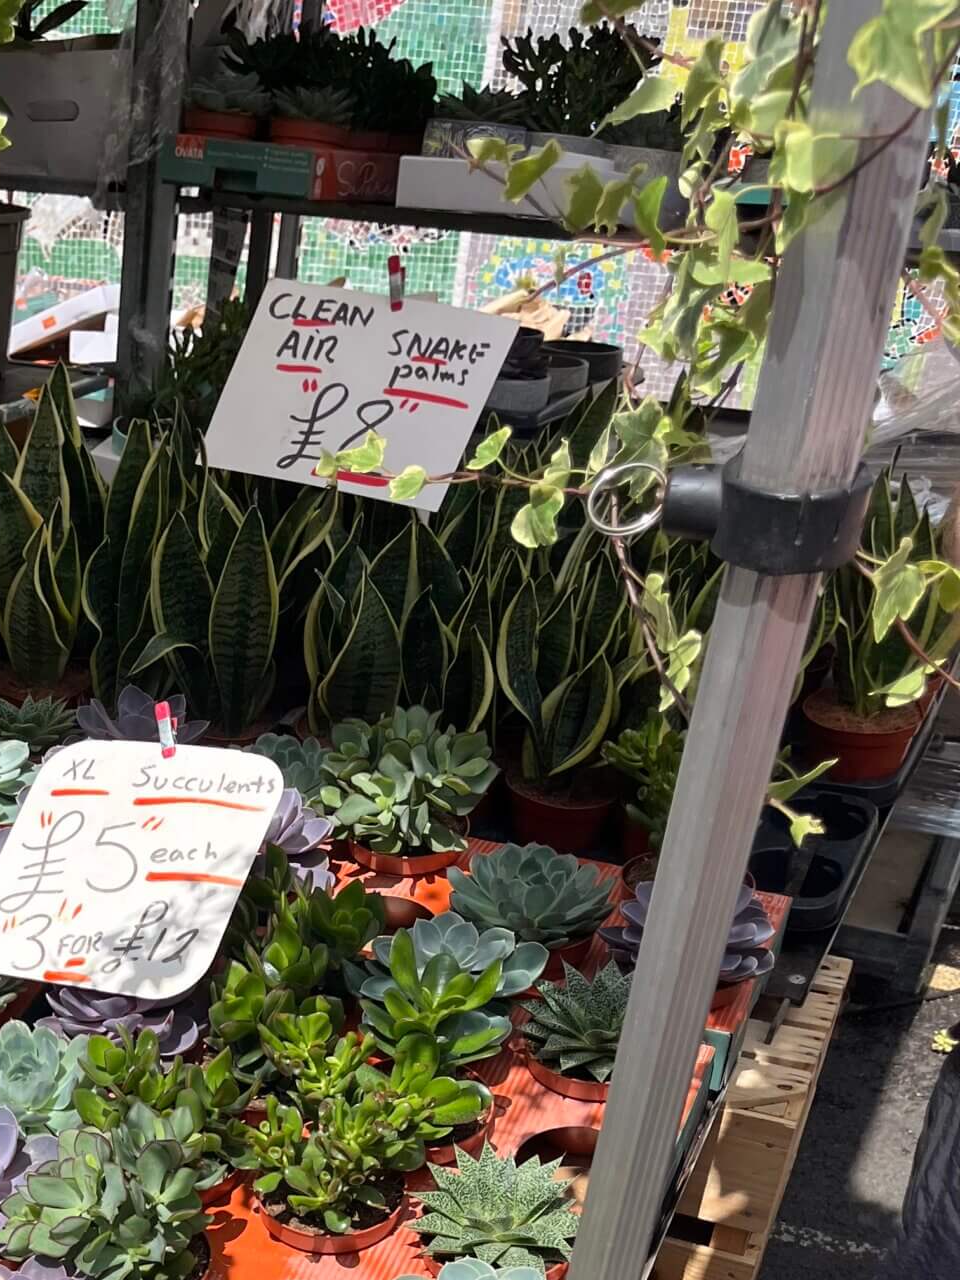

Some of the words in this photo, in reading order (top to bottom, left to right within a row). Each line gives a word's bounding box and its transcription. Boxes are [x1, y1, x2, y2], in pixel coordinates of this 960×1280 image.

[269, 293, 374, 327] CLEAN
[390, 363, 469, 388] palms
[62, 758, 96, 781] XL
[132, 764, 276, 792] Succulents
[150, 842, 218, 864] each
[57, 931, 104, 957] FOR
[100, 900, 200, 974] £12
